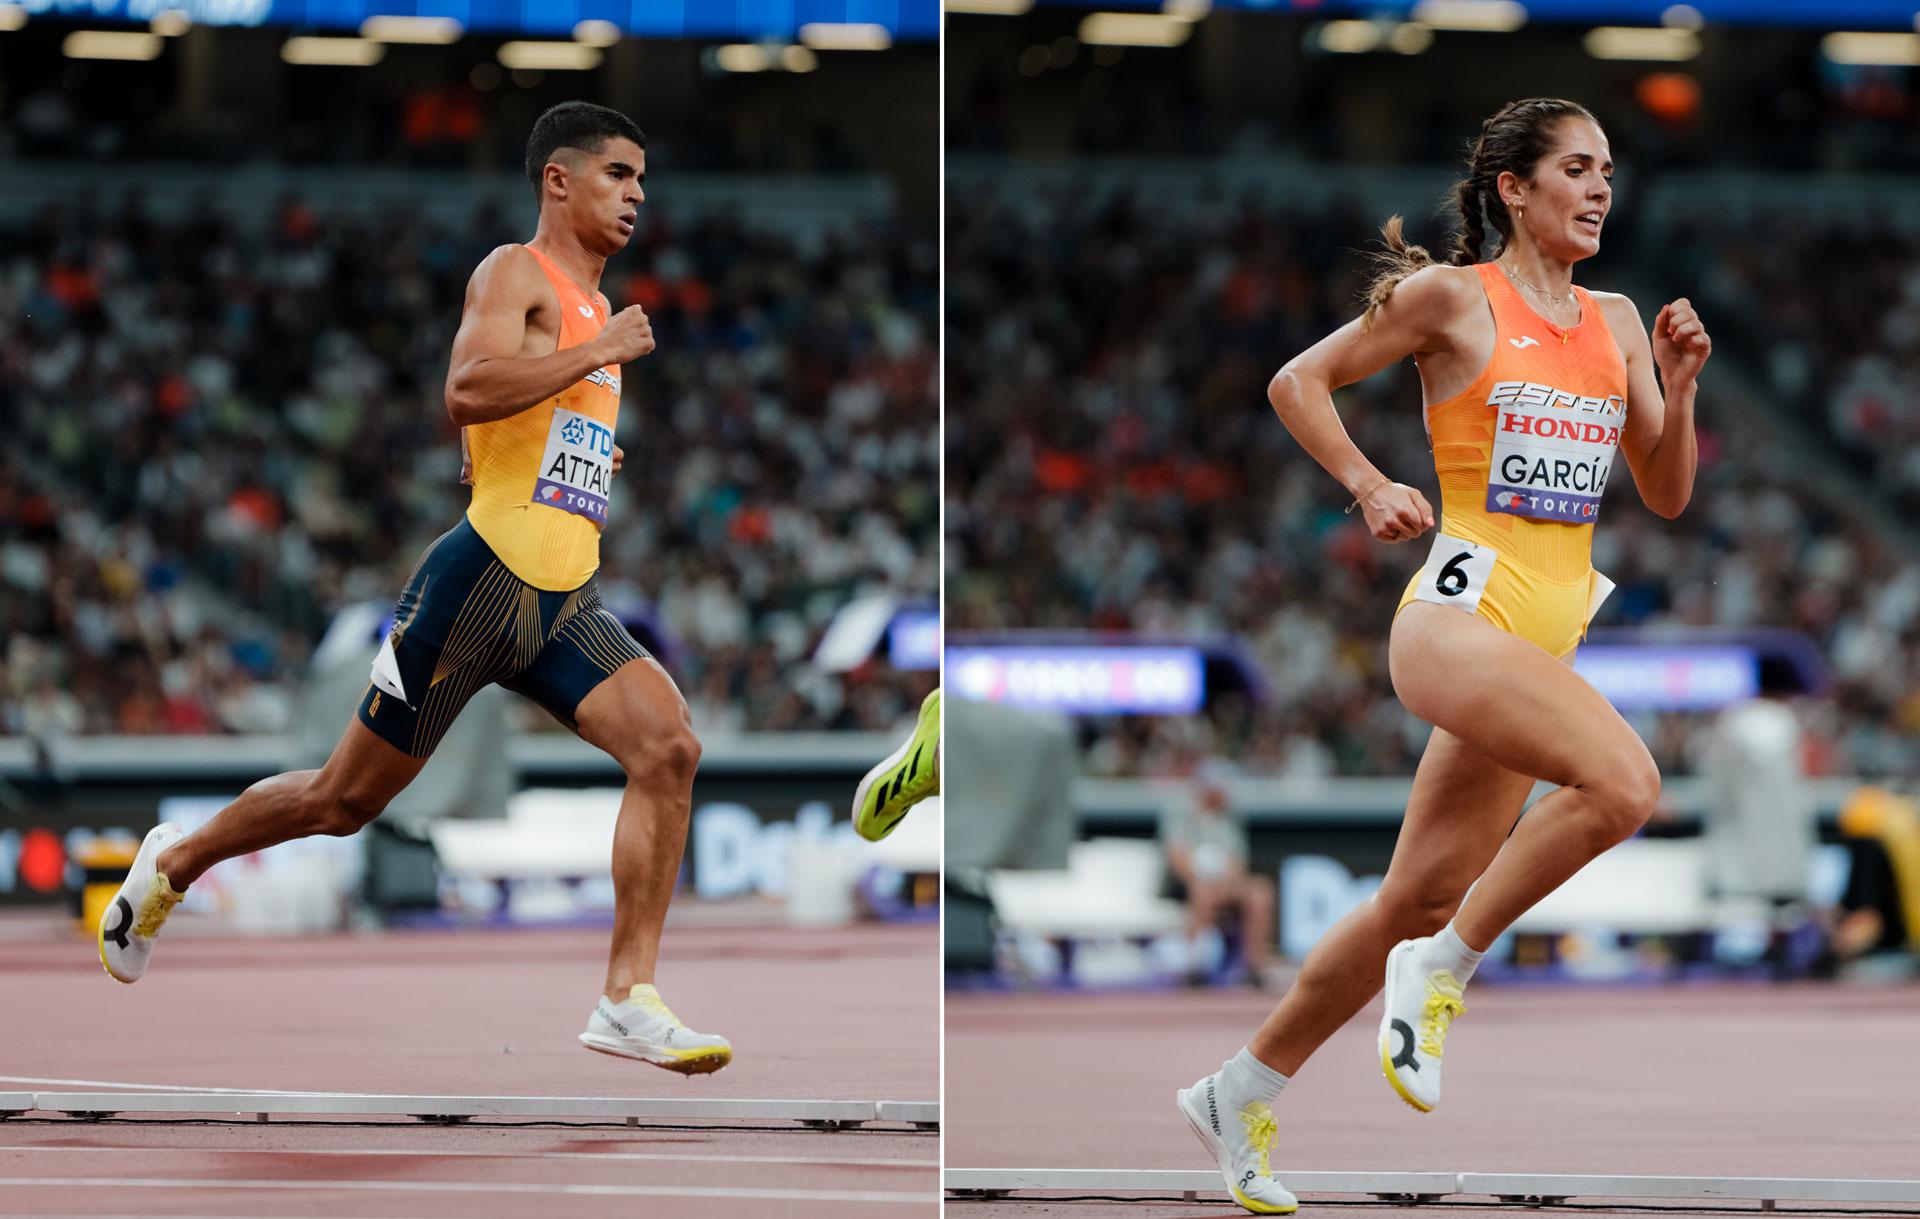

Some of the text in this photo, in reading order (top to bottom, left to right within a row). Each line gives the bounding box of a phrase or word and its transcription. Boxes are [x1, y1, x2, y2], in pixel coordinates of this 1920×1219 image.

[586, 422, 614, 457] TD
[1501, 412, 1619, 446] HONDA
[1436, 551, 1474, 597] 6
[1206, 1086, 1221, 1137] RUNNING
